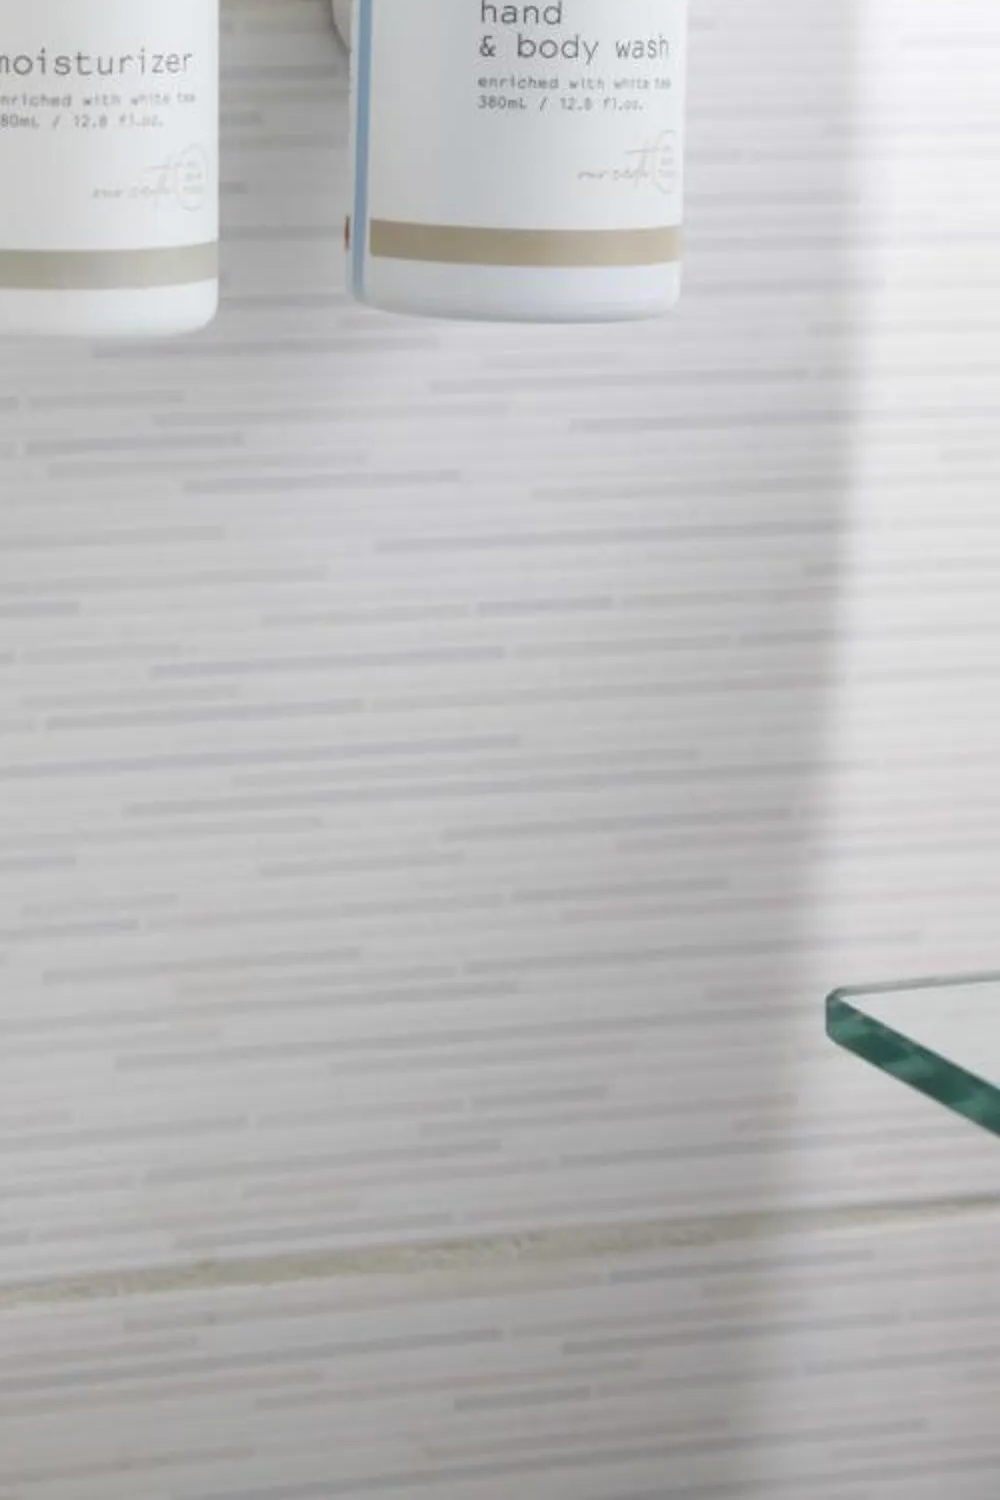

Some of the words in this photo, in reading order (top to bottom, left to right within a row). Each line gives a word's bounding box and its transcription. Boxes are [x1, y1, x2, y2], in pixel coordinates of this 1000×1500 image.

[479, 35, 497, 58] &
[516, 34, 600, 66] body
[615, 34, 669, 60] wash
[478, 74, 559, 90] enriched
[569, 75, 604, 92] with
